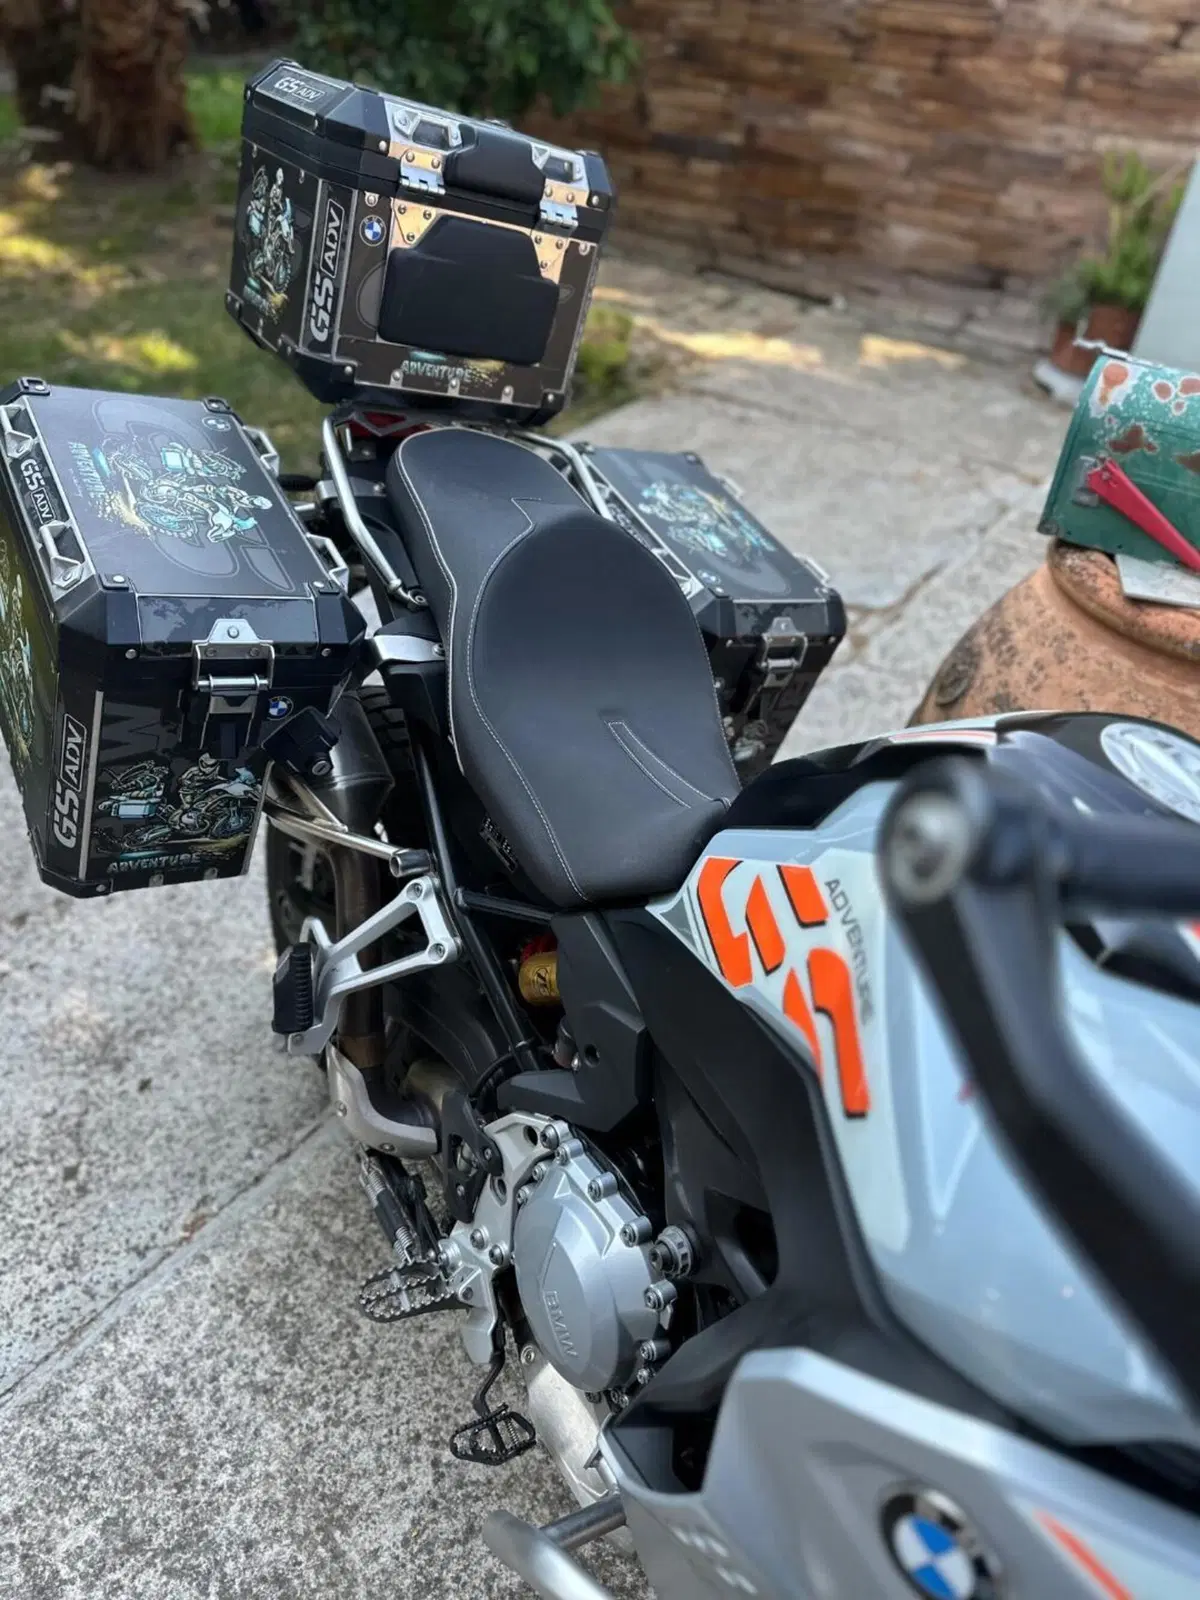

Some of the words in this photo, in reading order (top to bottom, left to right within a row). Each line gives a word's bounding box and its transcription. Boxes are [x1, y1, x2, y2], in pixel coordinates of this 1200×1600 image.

[273, 76, 305, 93] GS
[294, 87, 322, 100] ADV
[310, 271, 334, 342] GS
[323, 205, 342, 273] ADV
[20, 458, 45, 491] GS
[33, 493, 53, 518] ADV
[65, 721, 82, 785] ADV
[54, 780, 79, 848] GS
[106, 852, 201, 873] ADVENTURE
[545, 1290, 579, 1357] BMW
